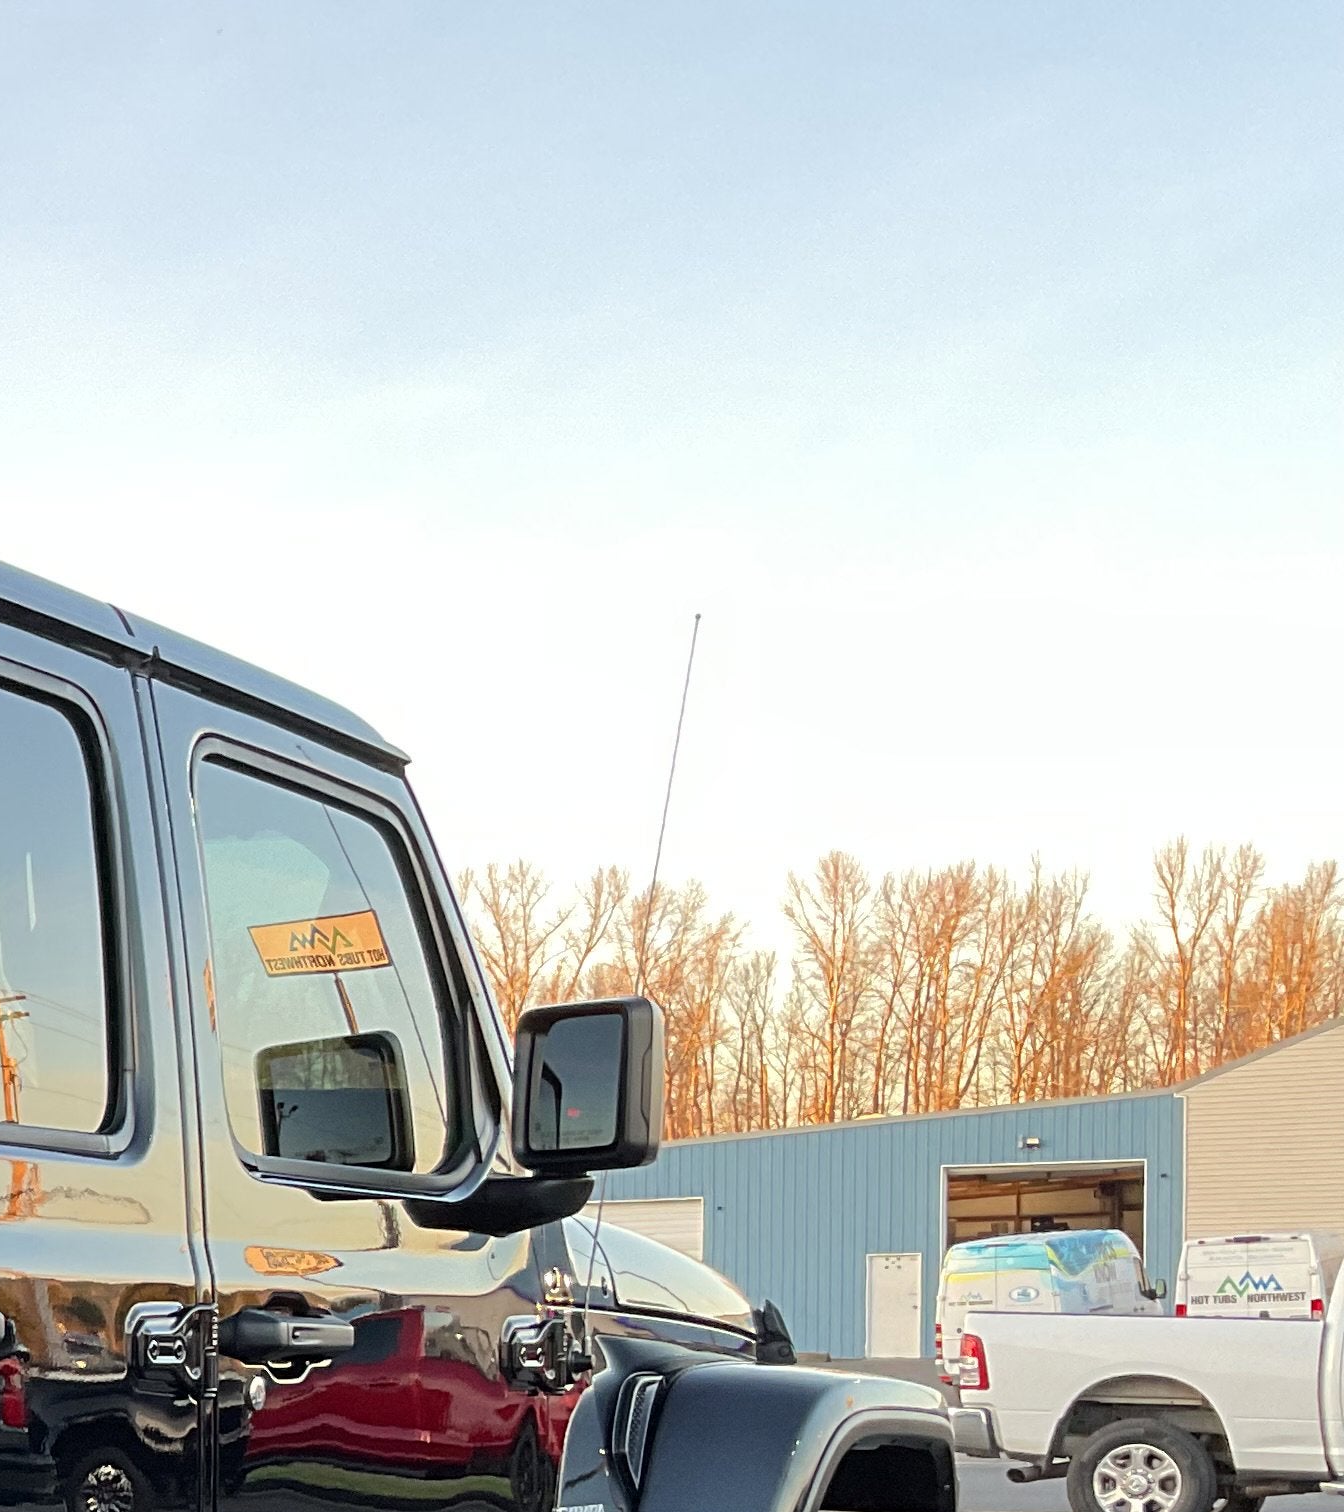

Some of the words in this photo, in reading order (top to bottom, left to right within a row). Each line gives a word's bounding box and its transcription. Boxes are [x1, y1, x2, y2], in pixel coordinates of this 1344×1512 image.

[1190, 1295, 1209, 1305] HOT
[1212, 1294, 1238, 1304] TUBS
[1247, 1291, 1307, 1303] NORTHWEST
